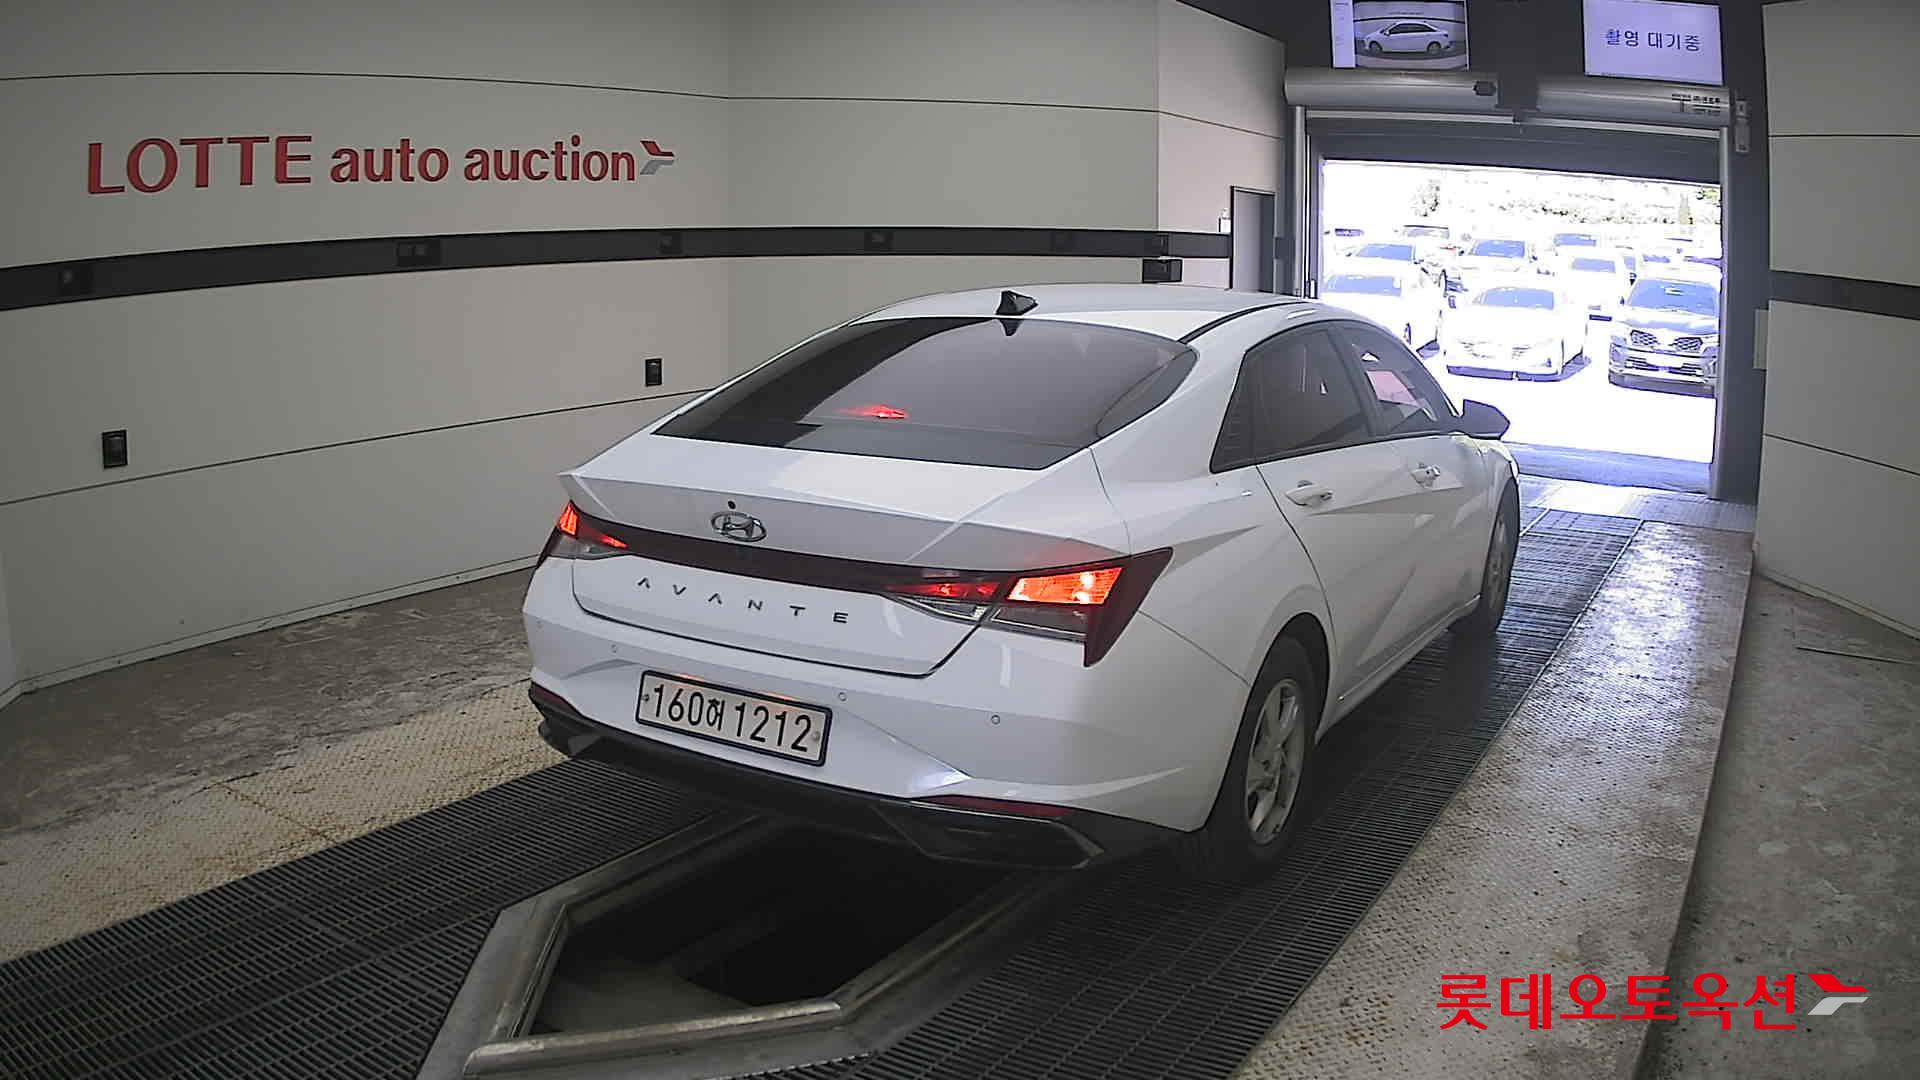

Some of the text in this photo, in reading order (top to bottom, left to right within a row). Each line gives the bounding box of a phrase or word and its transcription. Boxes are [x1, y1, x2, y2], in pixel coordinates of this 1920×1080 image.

[1647, 32, 1701, 52] 대기중
[87, 134, 635, 194] LOTTE auto auction
[637, 577, 849, 624] AVANTE
